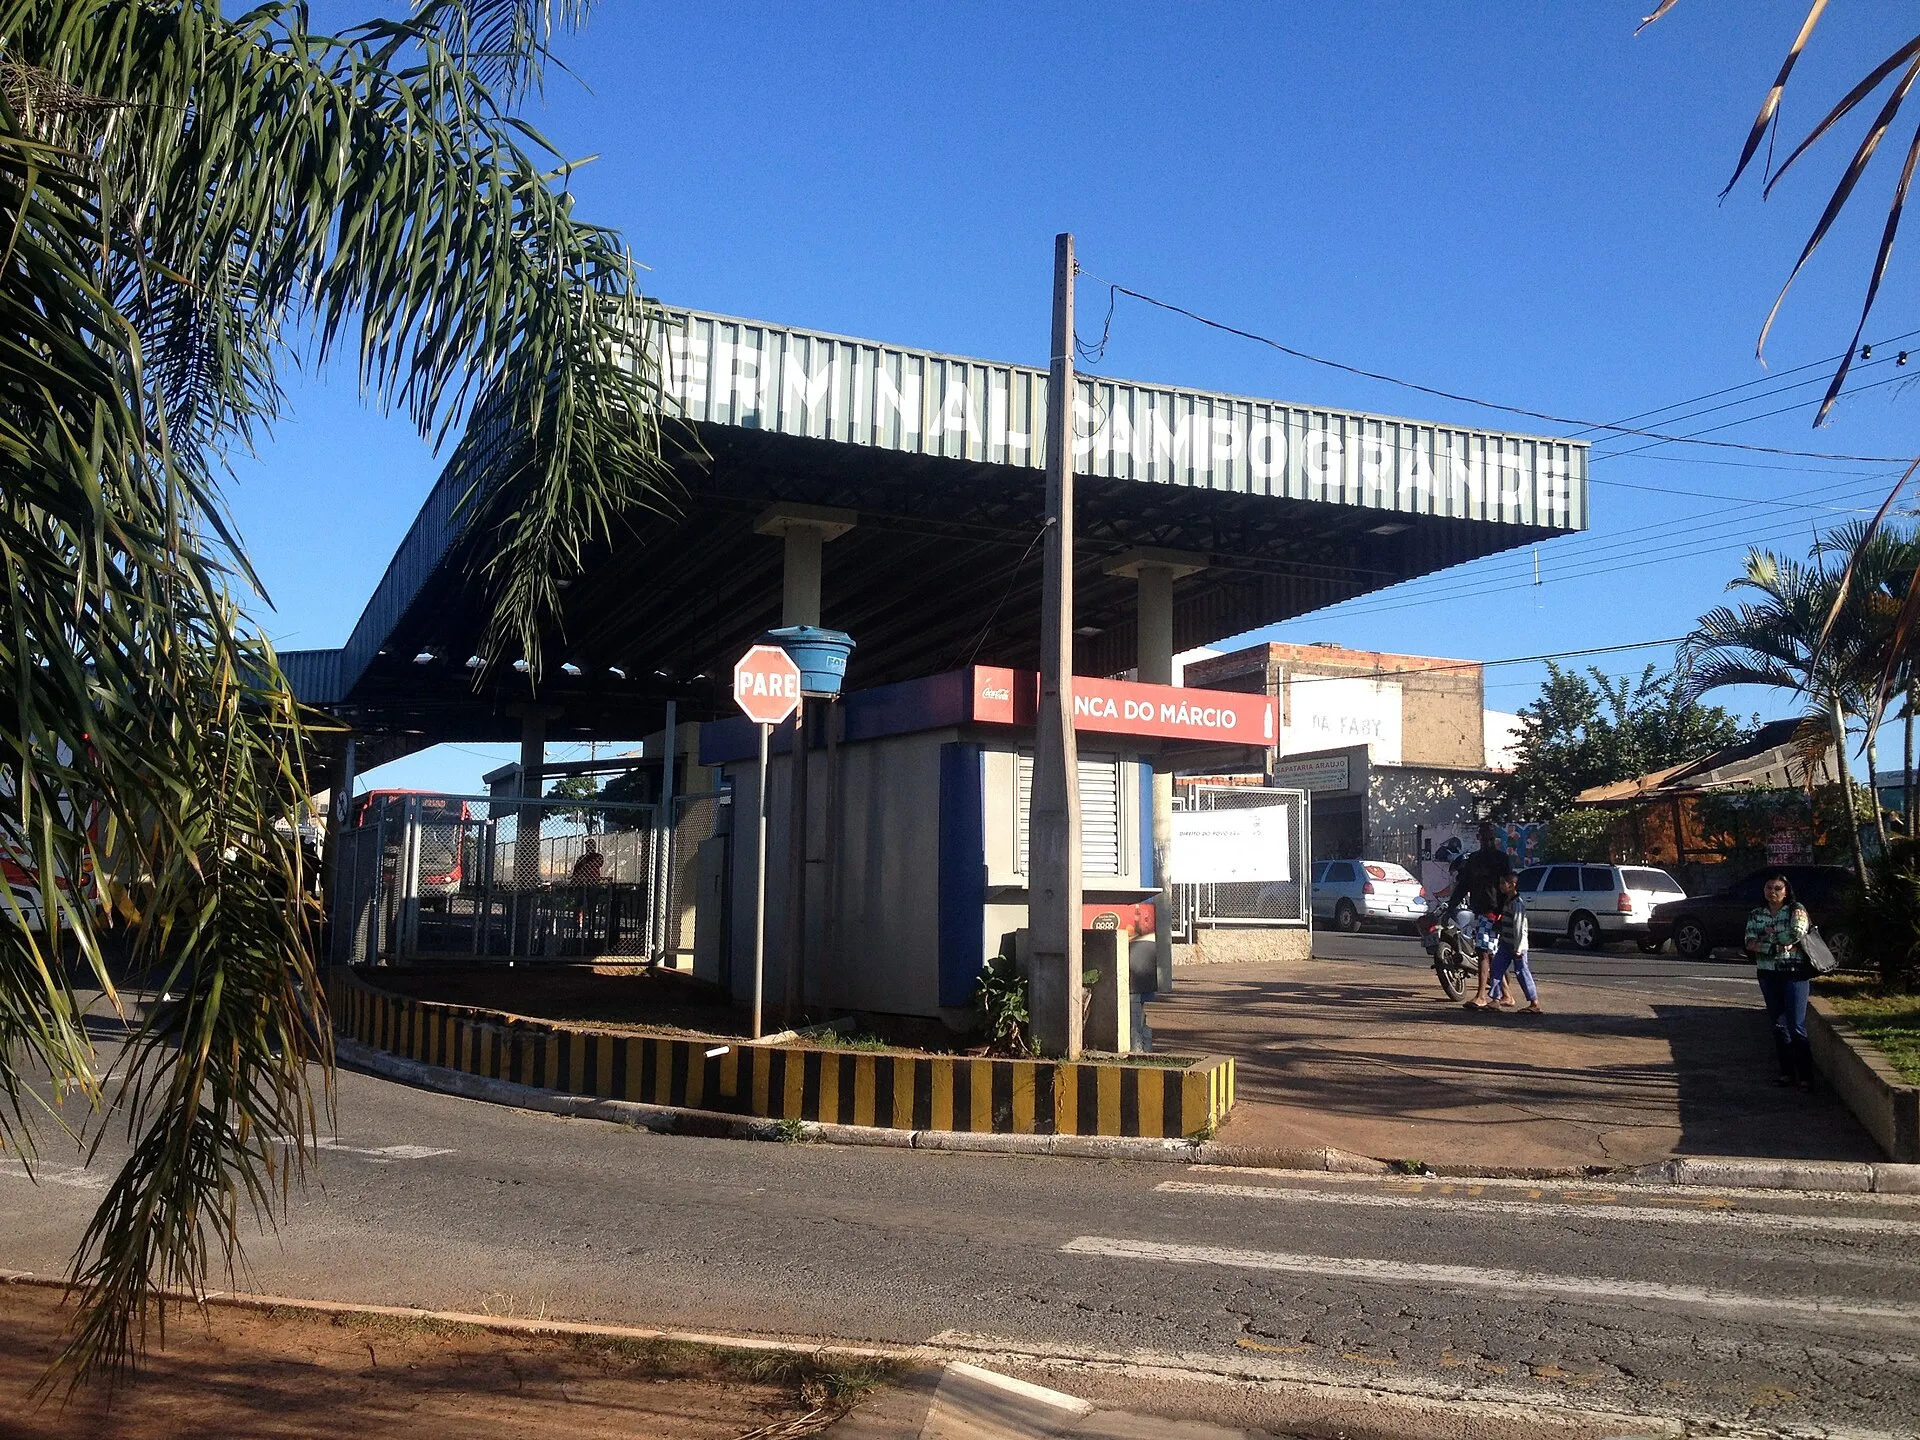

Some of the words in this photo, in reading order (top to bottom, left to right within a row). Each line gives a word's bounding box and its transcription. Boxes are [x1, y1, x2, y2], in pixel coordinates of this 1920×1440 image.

[1300, 430, 1566, 511] GRANDE
[740, 671, 797, 698] PARE
[1074, 695, 1119, 719] NCA
[1124, 701, 1154, 721] DO
[1160, 700, 1237, 729] MÁRCIO
[1276, 764, 1314, 774] SAPATARIA
[1315, 760, 1345, 770] ARAUJO
